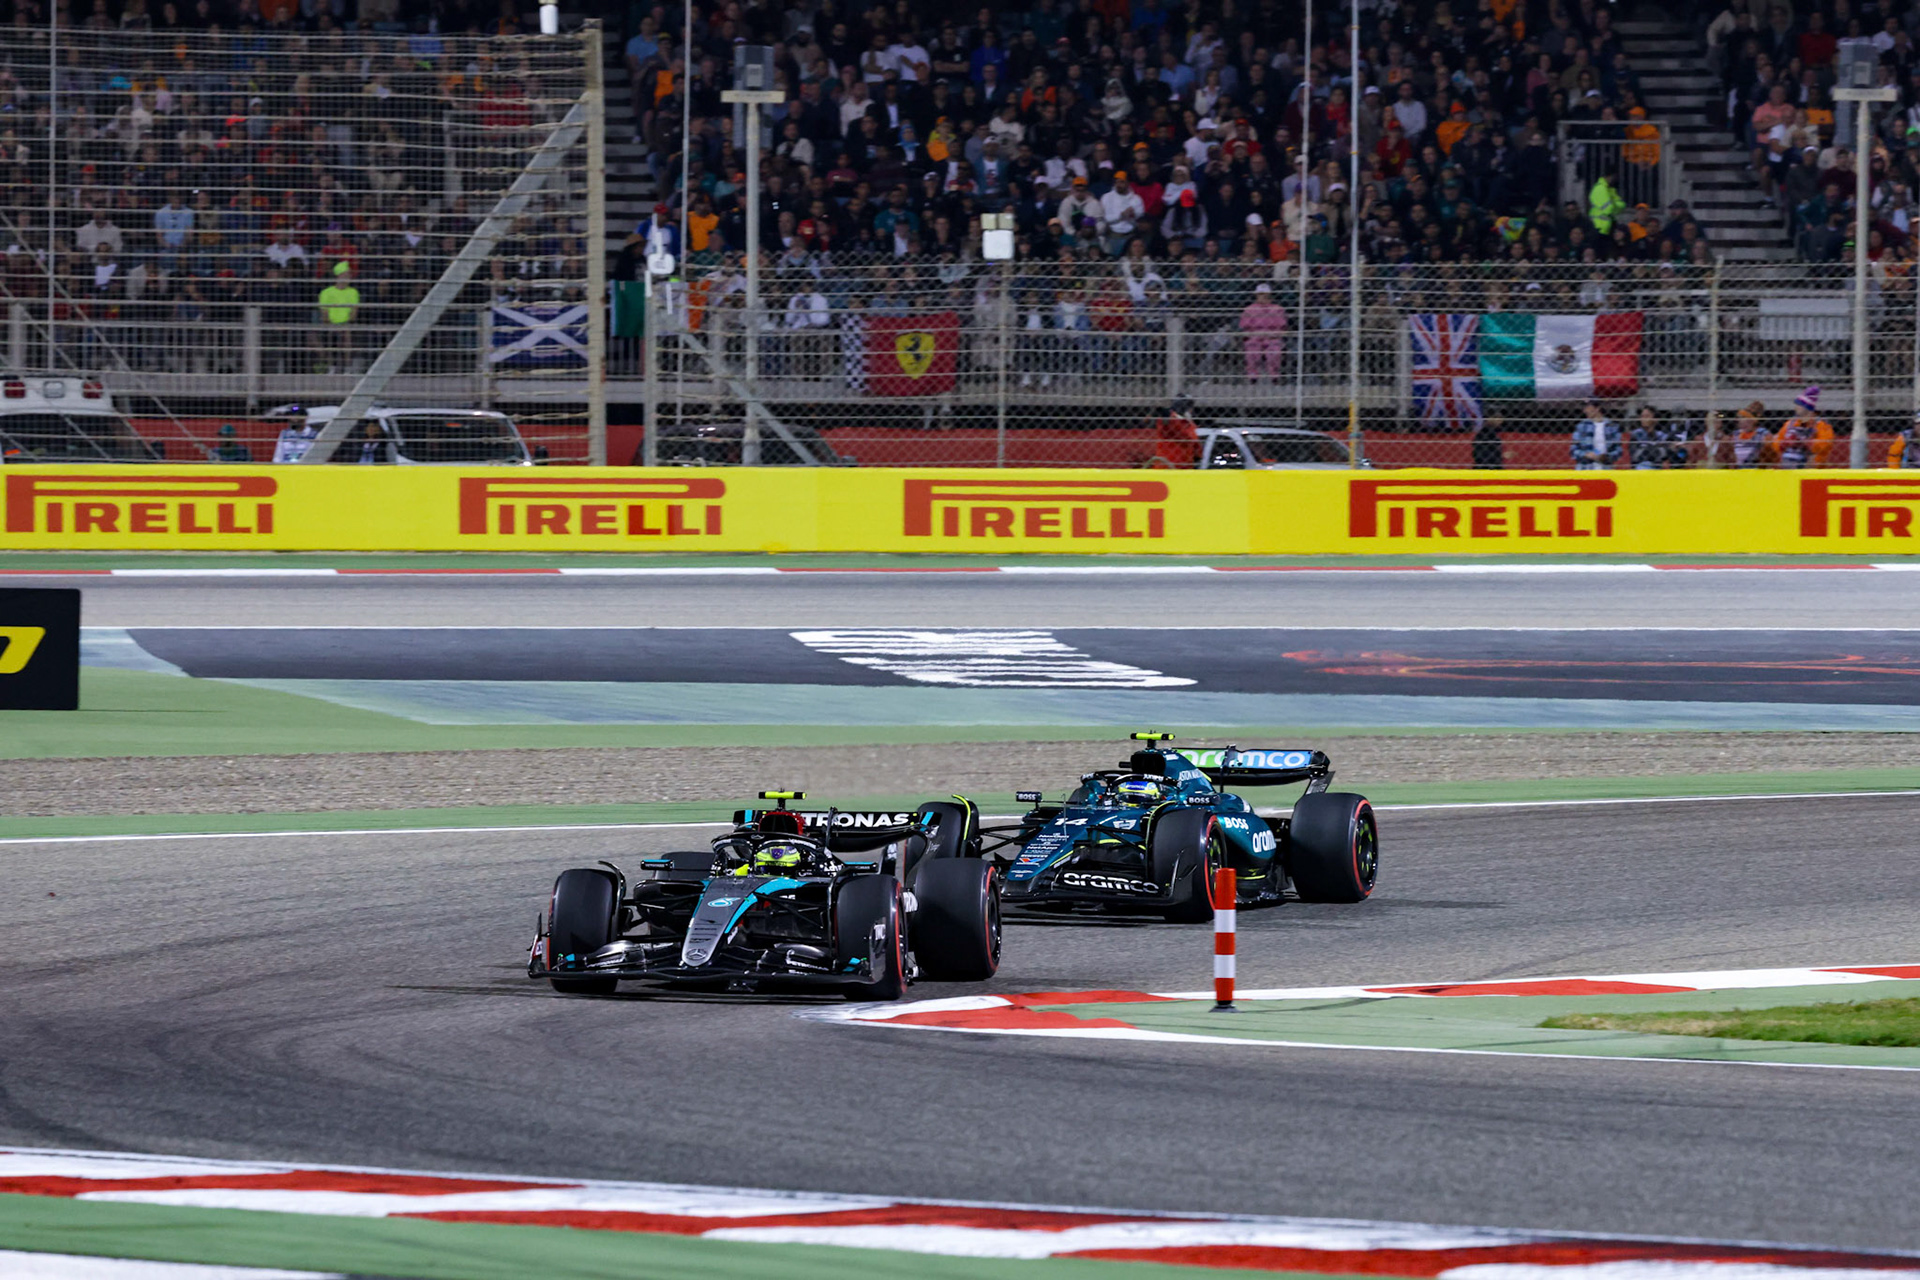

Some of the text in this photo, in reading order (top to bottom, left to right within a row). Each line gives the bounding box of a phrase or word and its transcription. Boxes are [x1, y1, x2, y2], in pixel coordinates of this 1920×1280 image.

[6, 475, 277, 533] PIRELLI
[459, 477, 725, 535] PIRELLI
[904, 480, 1168, 537] PIRELLI
[1349, 479, 1617, 537] PIRELLI
[800, 813, 909, 828] TRONAS
[1055, 817, 1089, 826] 14
[1224, 817, 1249, 830] BOSS
[1252, 830, 1277, 853] aram
[1063, 872, 1159, 894] aramco
